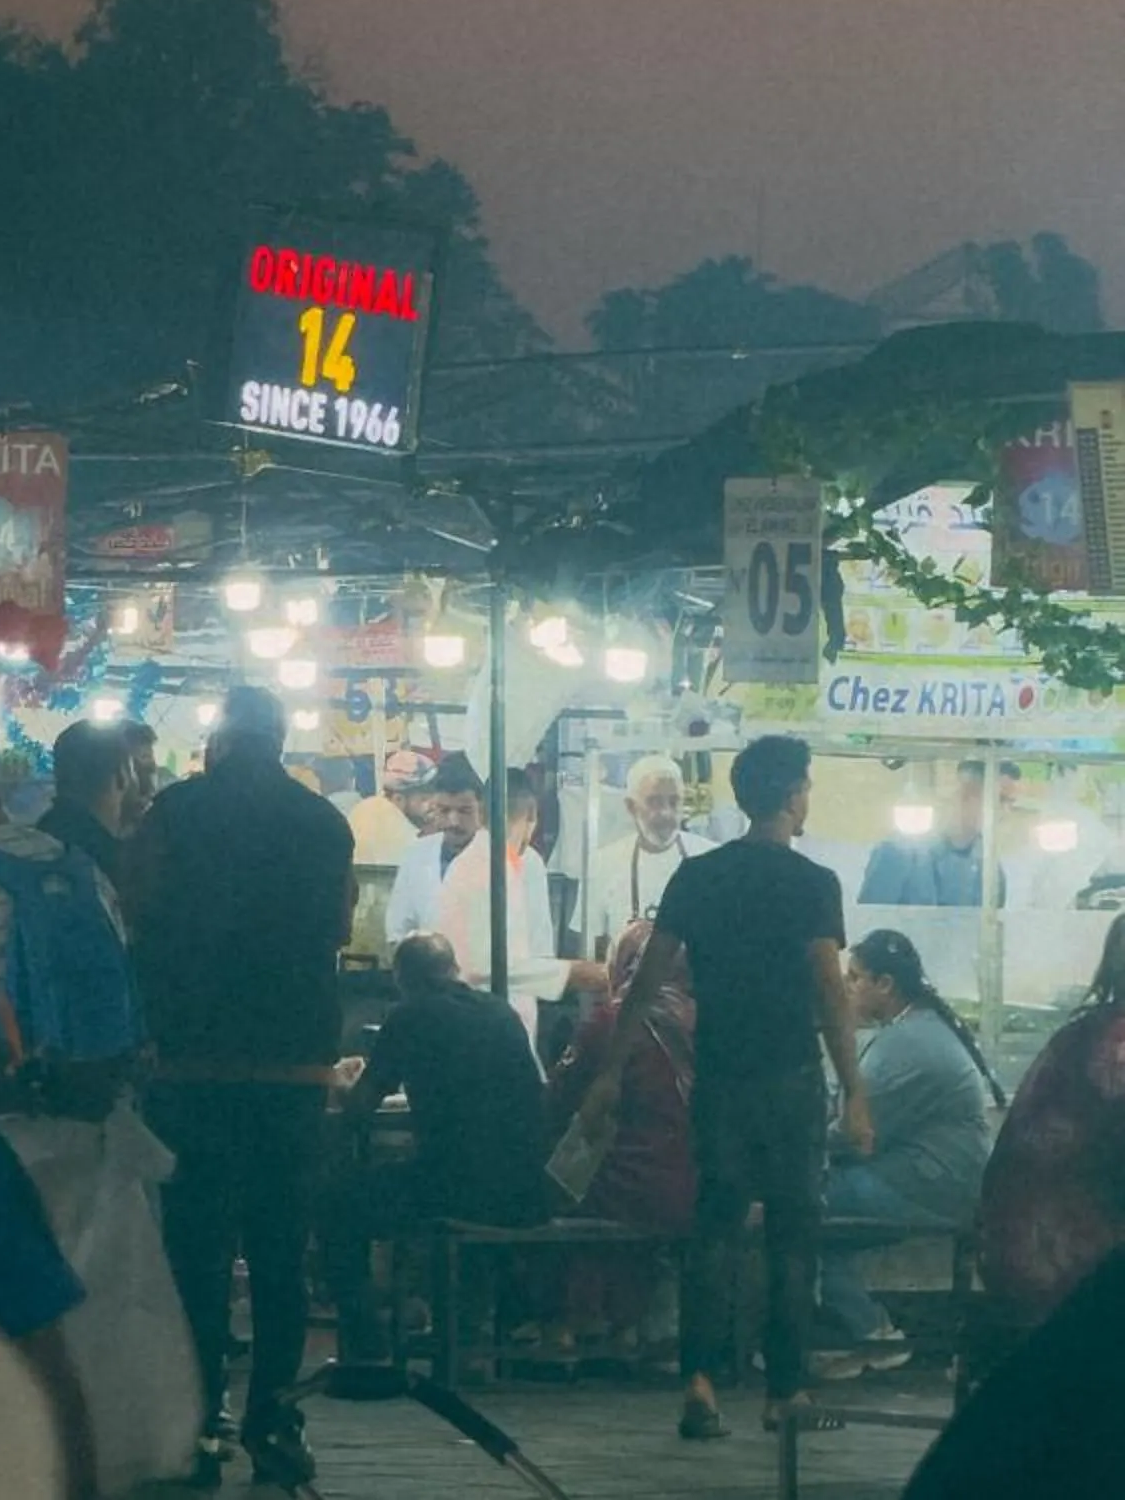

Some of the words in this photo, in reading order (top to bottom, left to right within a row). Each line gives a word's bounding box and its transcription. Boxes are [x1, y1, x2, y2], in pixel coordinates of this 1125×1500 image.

[249, 245, 420, 321] ORIGINAL
[298, 305, 357, 393] 14
[240, 380, 327, 434] SINCE
[333, 396, 400, 447] 1966
[748, 541, 813, 636] 05
[827, 675, 909, 714] Chez
[917, 681, 1006, 717] KRITA
